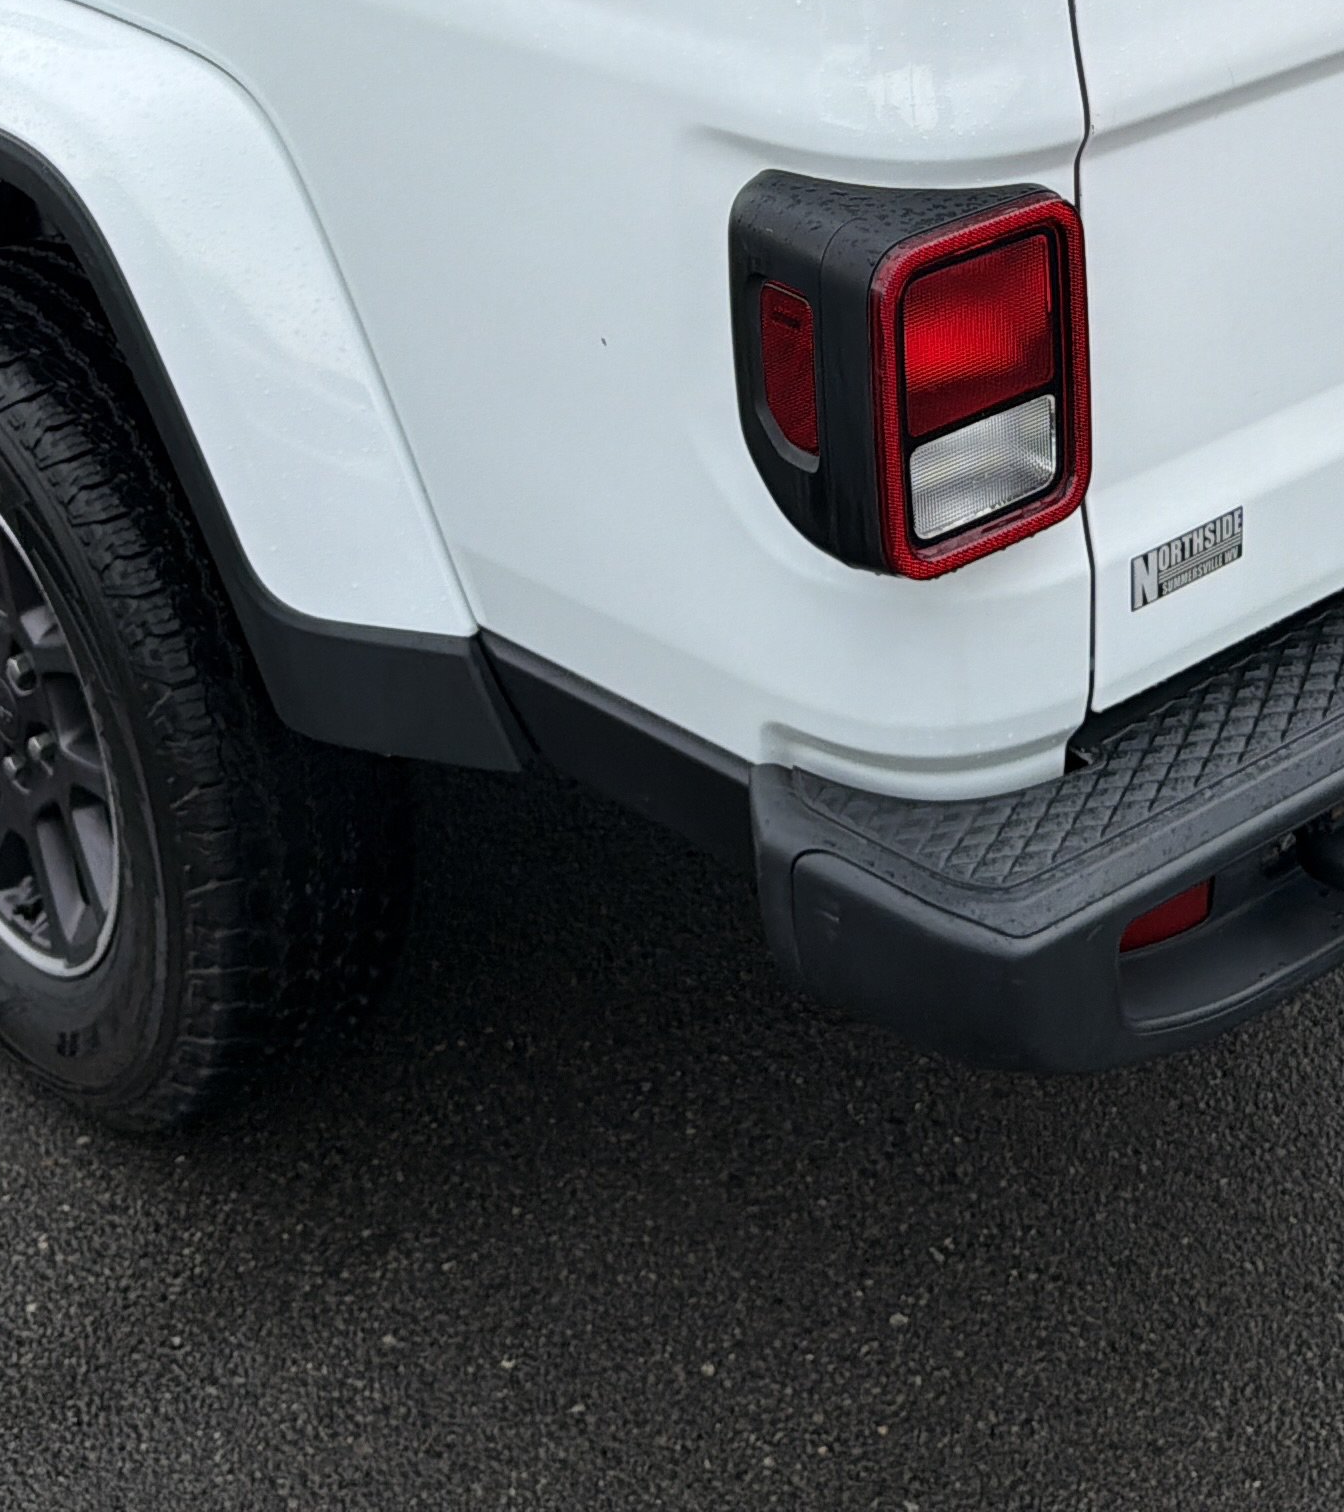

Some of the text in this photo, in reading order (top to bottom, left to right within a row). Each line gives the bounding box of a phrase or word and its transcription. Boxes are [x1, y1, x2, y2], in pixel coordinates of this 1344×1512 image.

[1133, 509, 1241, 609] NORTHSIDE
[1162, 546, 1239, 595] SUMMERSVILLE WV
